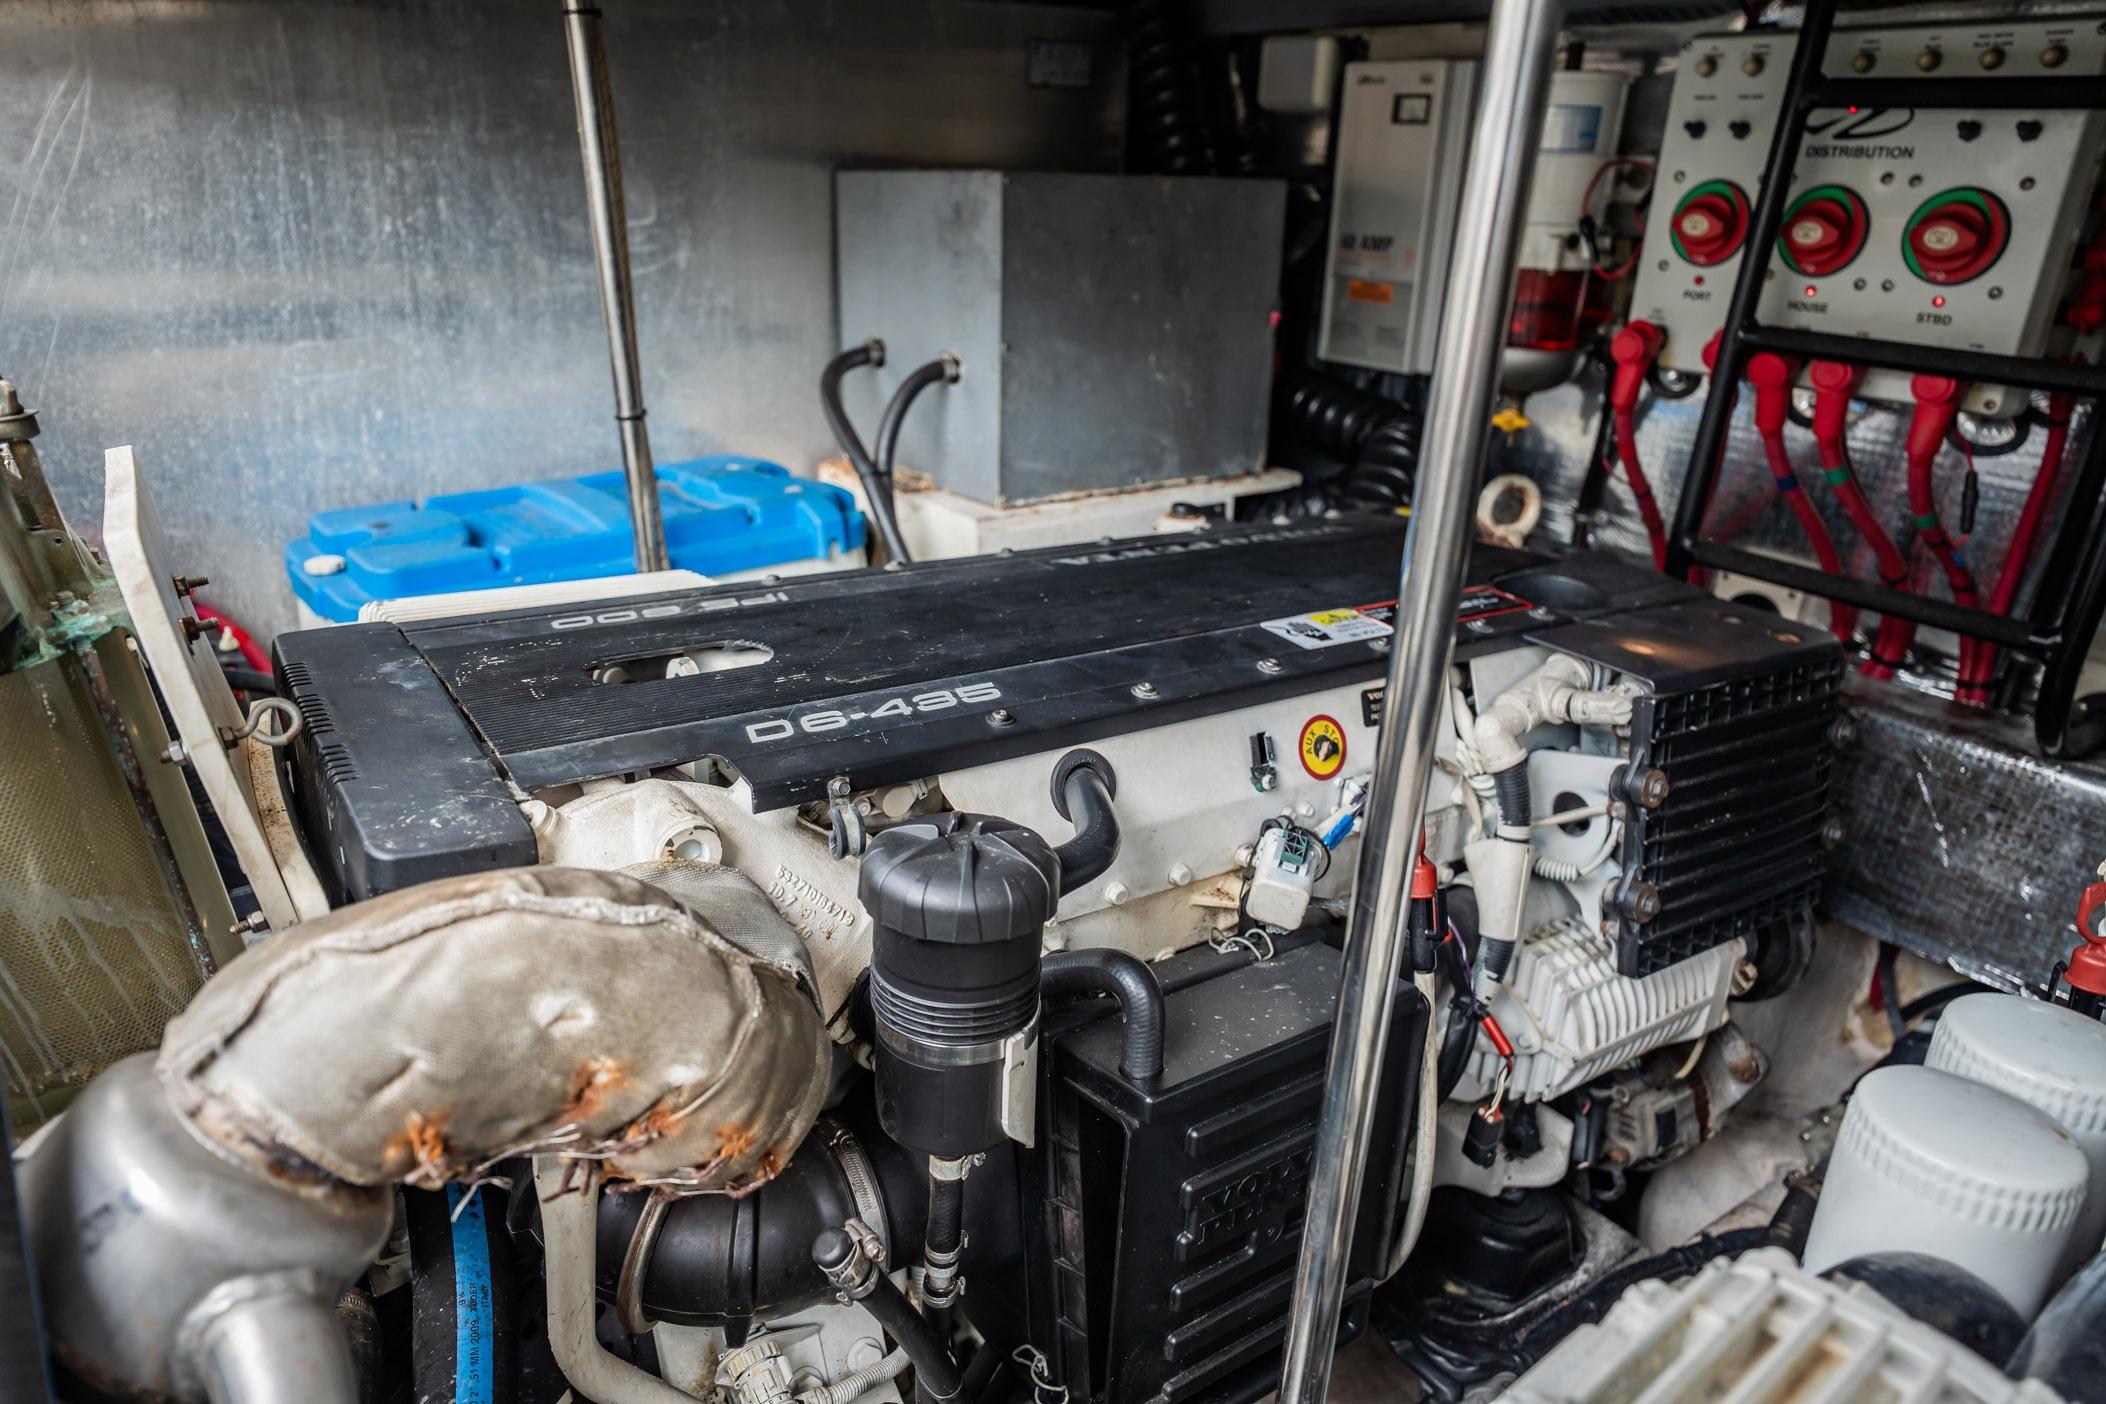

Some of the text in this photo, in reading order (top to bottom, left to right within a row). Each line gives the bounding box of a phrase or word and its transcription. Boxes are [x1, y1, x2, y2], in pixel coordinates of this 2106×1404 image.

[1805, 144, 1914, 159] DISTRIBUTION
[1683, 289, 1711, 301] PORT
[1787, 300, 1829, 314] HOUSE
[1916, 312, 1953, 326] STBD
[745, 682, 1002, 744] D6-435
[1305, 728, 1316, 755] AUX
[470, 1319, 480, 1344] 2009
